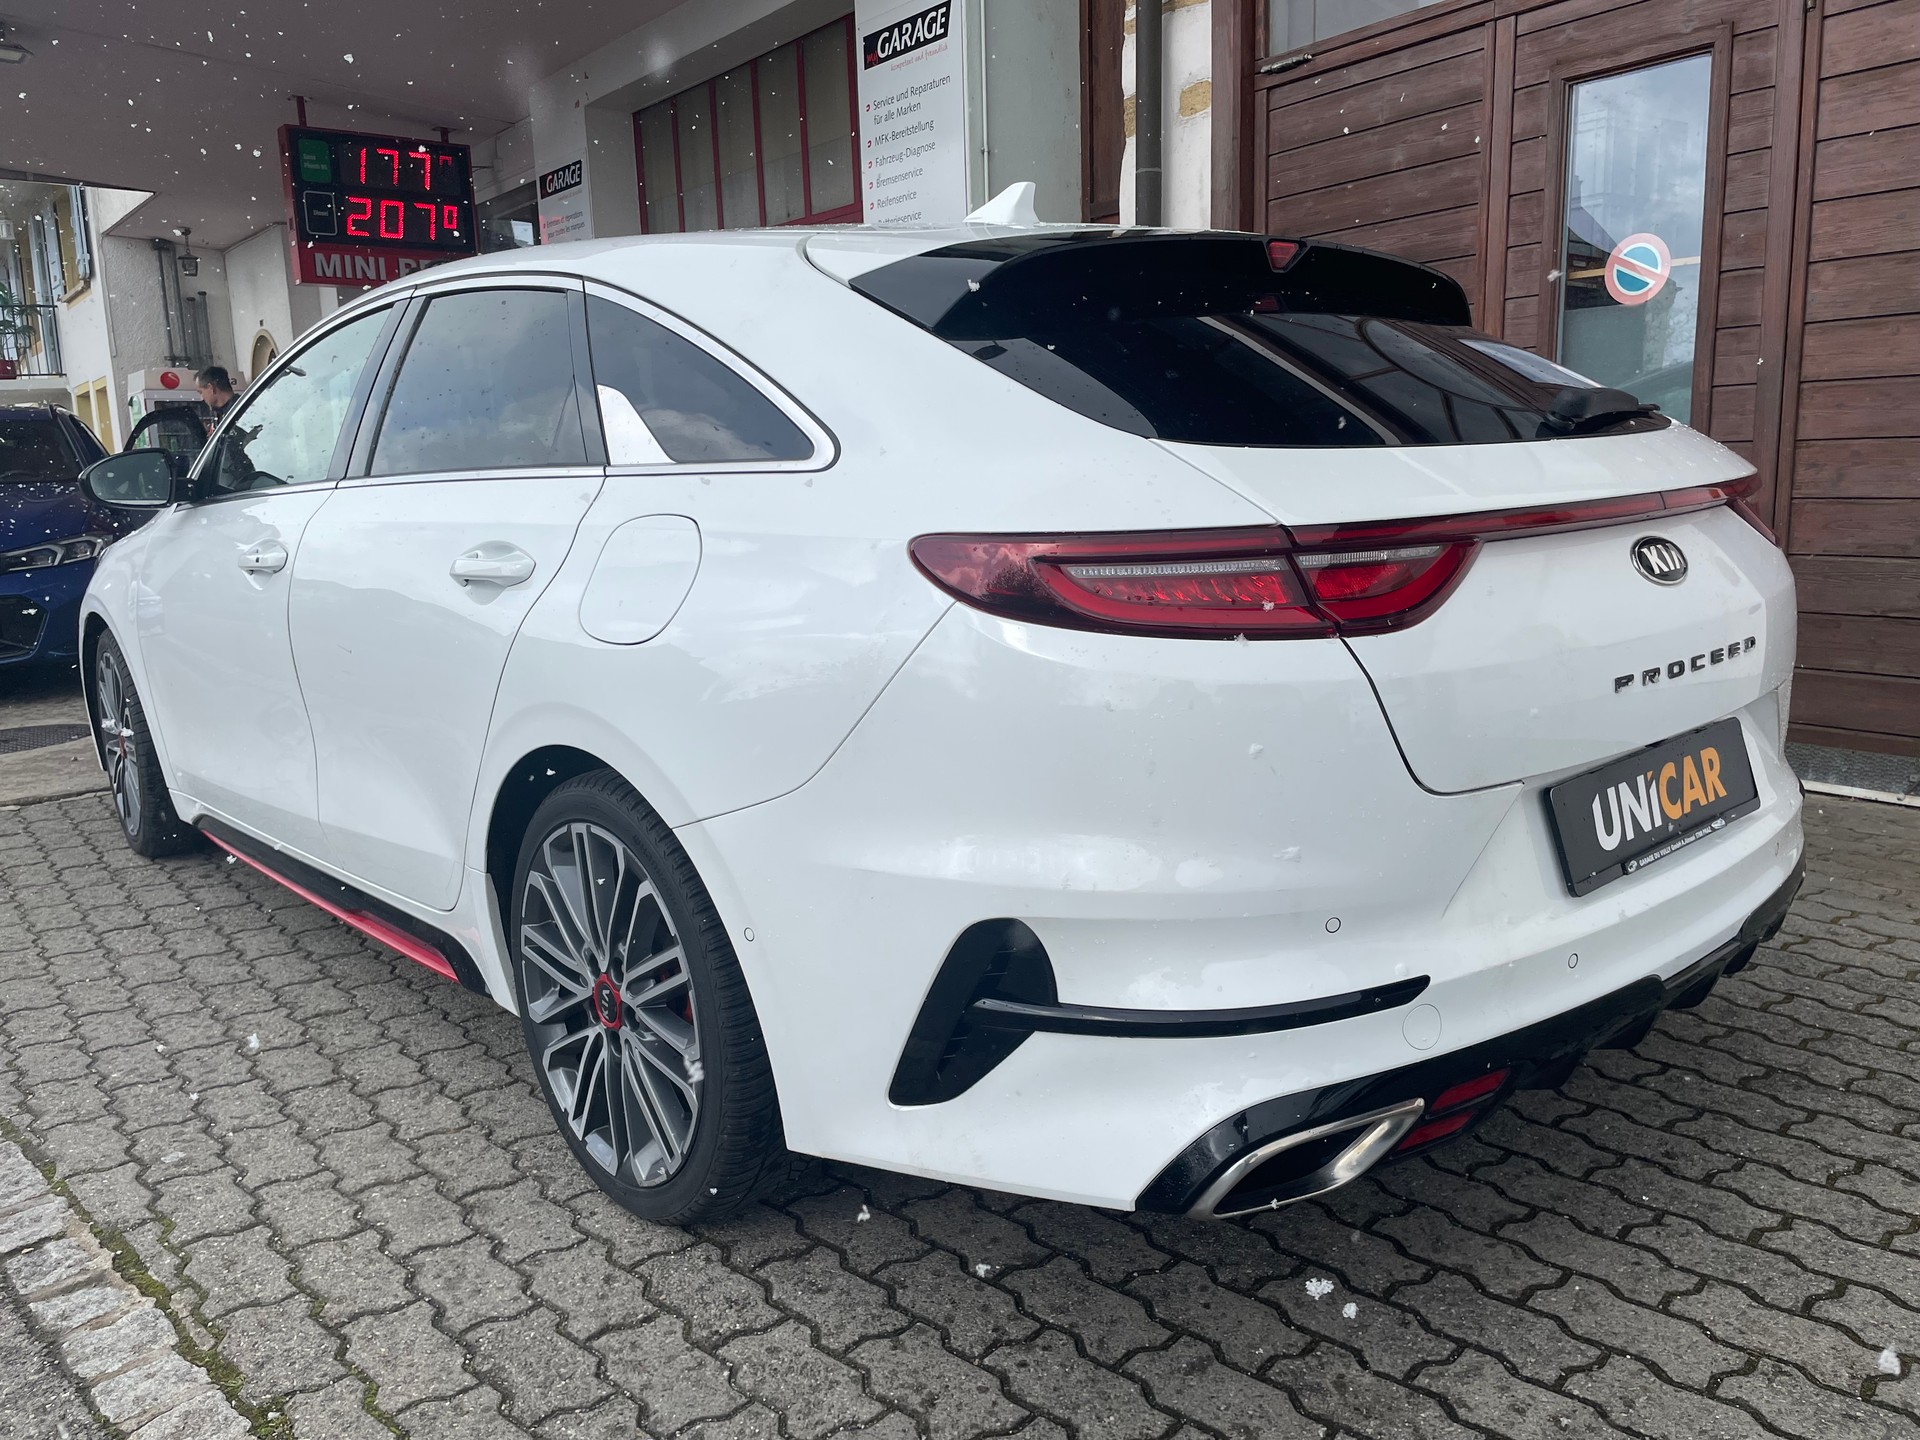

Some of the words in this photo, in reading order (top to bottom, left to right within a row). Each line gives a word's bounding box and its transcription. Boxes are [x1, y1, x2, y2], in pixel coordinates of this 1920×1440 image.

[915, 51, 924, 62] und
[873, 96, 895, 110] Service
[896, 88, 909, 102] und
[910, 75, 951, 97] Reparaturen
[874, 114, 883, 125] für
[884, 110, 895, 122] alle
[896, 102, 921, 118] Marken
[875, 120, 935, 147] MFK-Bereitstellung
[875, 142, 936, 167] Fahrzeug-Diagnose
[546, 164, 581, 193] GARAGE
[876, 168, 924, 188] Bremsenservice
[877, 191, 917, 209] Reifenservice
[314, 252, 387, 281] MINI
[1640, 542, 1687, 575] KIA
[1614, 636, 1757, 694] PROCEED
[601, 989, 610, 1020] KIA
